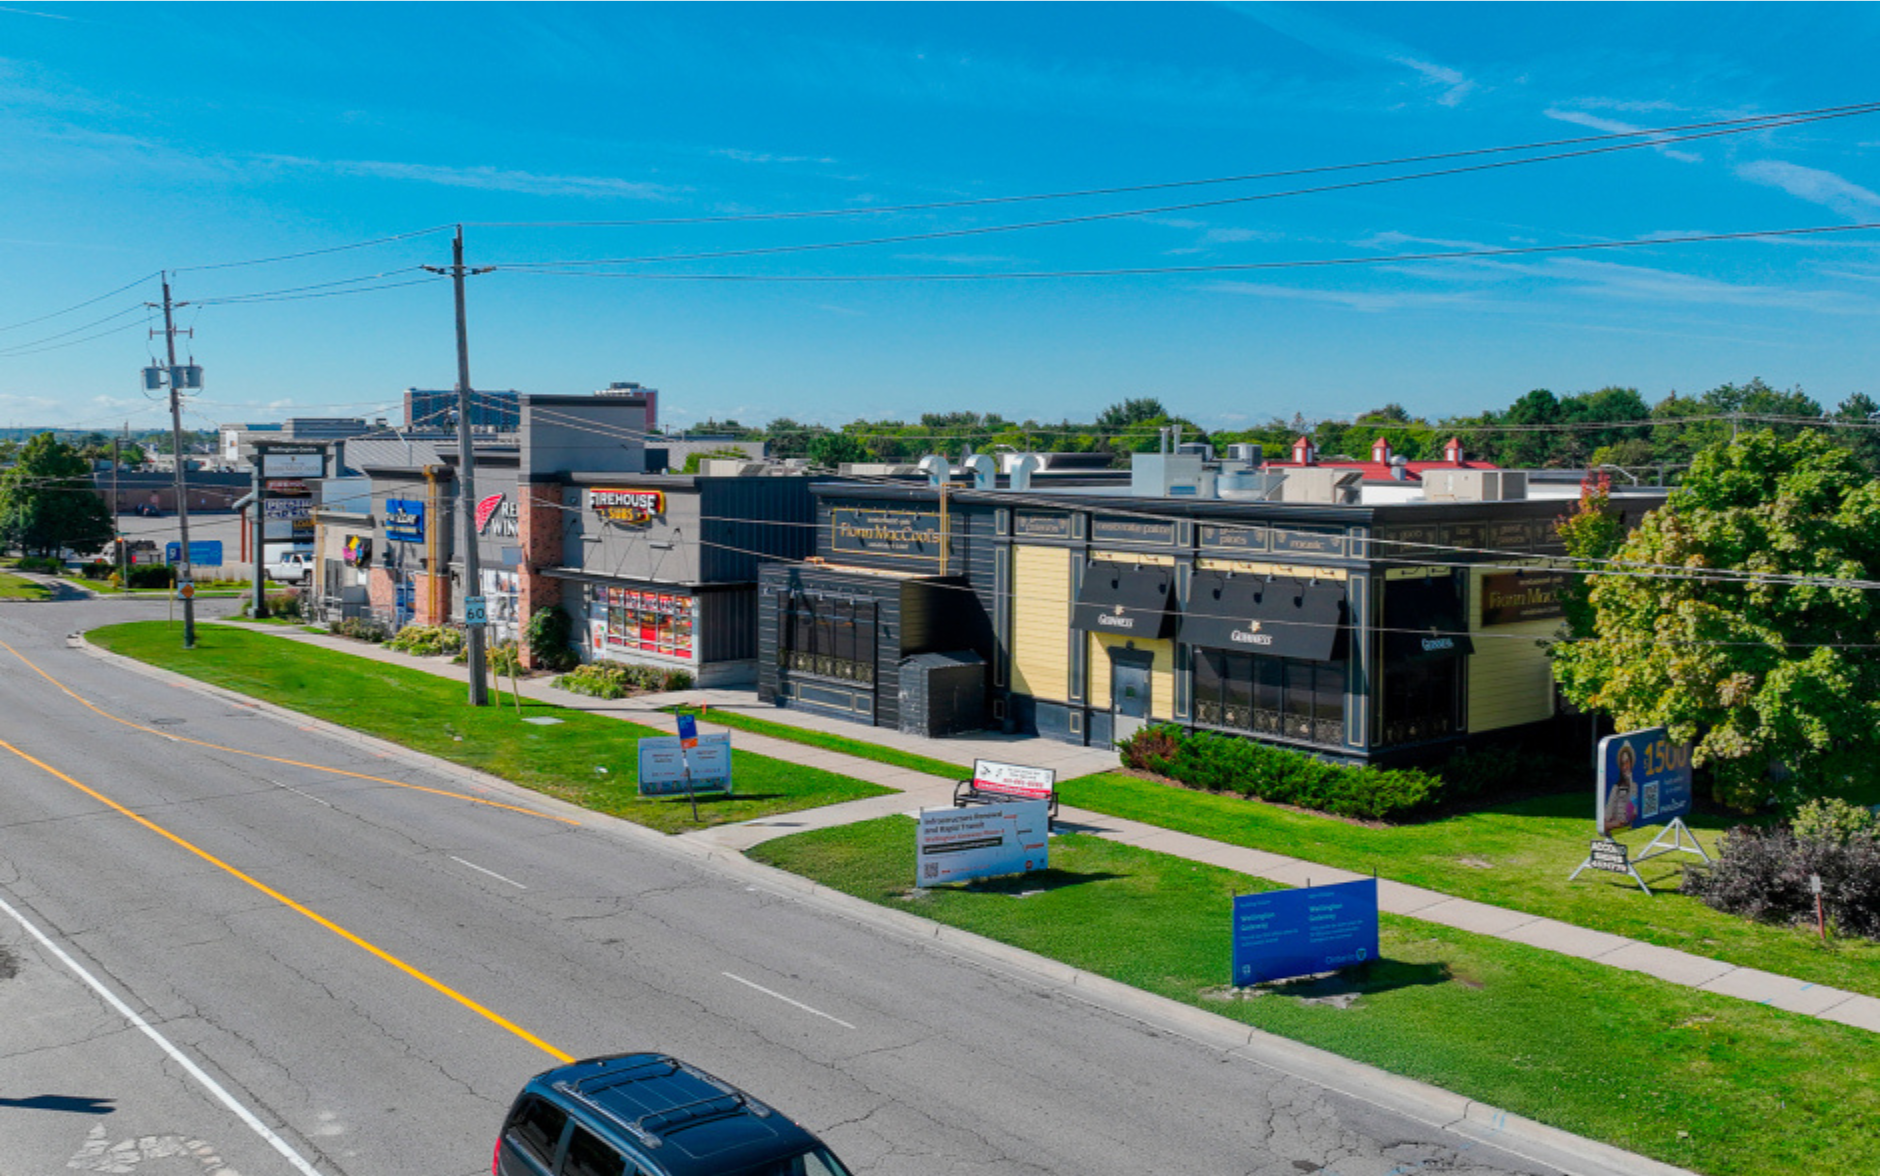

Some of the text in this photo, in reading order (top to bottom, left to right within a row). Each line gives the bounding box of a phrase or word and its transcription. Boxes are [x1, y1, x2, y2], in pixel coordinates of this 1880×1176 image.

[501, 502, 518, 518] RE
[590, 492, 657, 515] FIREHOUSE
[608, 507, 634, 520] SUBS
[491, 518, 518, 536] WIN
[468, 608, 485, 620] 60
[1098, 613, 1134, 628] GUINNESS
[1231, 629, 1273, 646] GUINNESS
